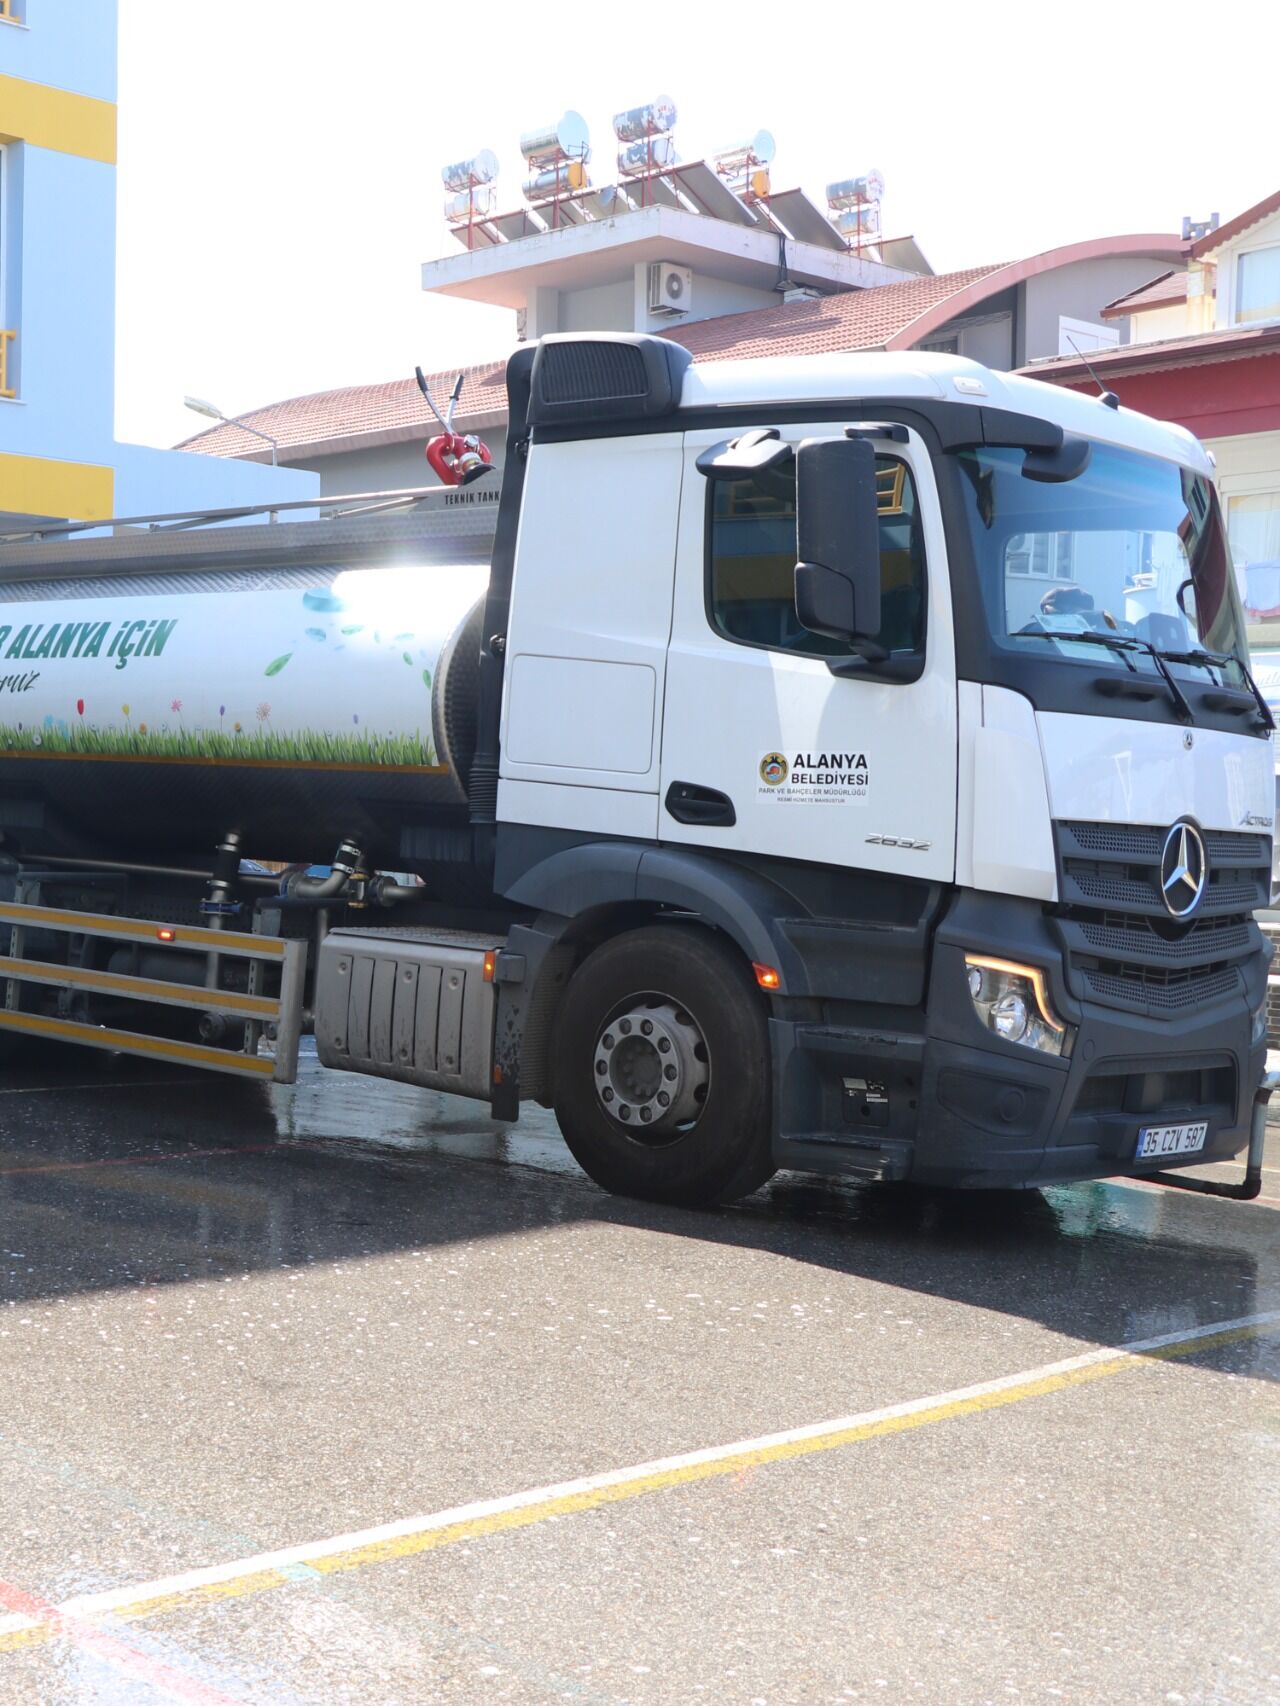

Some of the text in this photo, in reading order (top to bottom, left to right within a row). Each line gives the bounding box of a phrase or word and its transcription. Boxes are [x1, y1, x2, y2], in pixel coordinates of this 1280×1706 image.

[5, 621, 112, 659] ALANYA
[107, 618, 179, 670] İÇİN
[793, 754, 868, 769] ALANYA
[791, 771, 869, 786] BELEDİYESİ
[777, 787, 785, 795] VE
[787, 788, 822, 796] BAHÇELER
[823, 788, 866, 797] MÜDÜRLÜĞÜ
[864, 832, 932, 851] 2632
[1143, 1126, 1205, 1153] 35 CZV 587
